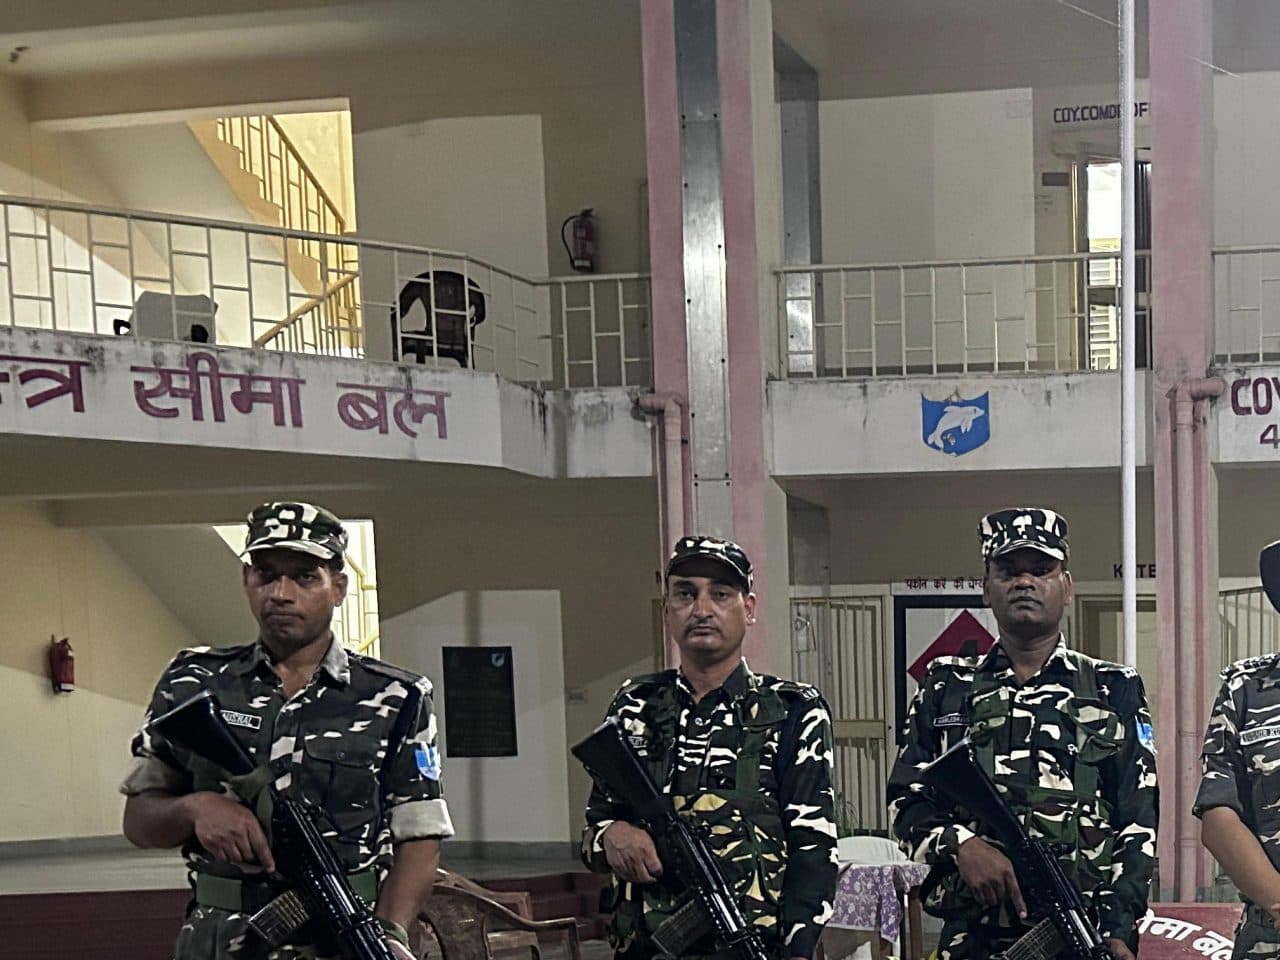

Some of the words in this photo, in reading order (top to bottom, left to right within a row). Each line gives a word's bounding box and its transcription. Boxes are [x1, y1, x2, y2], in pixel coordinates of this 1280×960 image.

[130, 351, 306, 428] सीमा
[336, 382, 452, 440] बल
[1113, 563, 1156, 578] KTE
